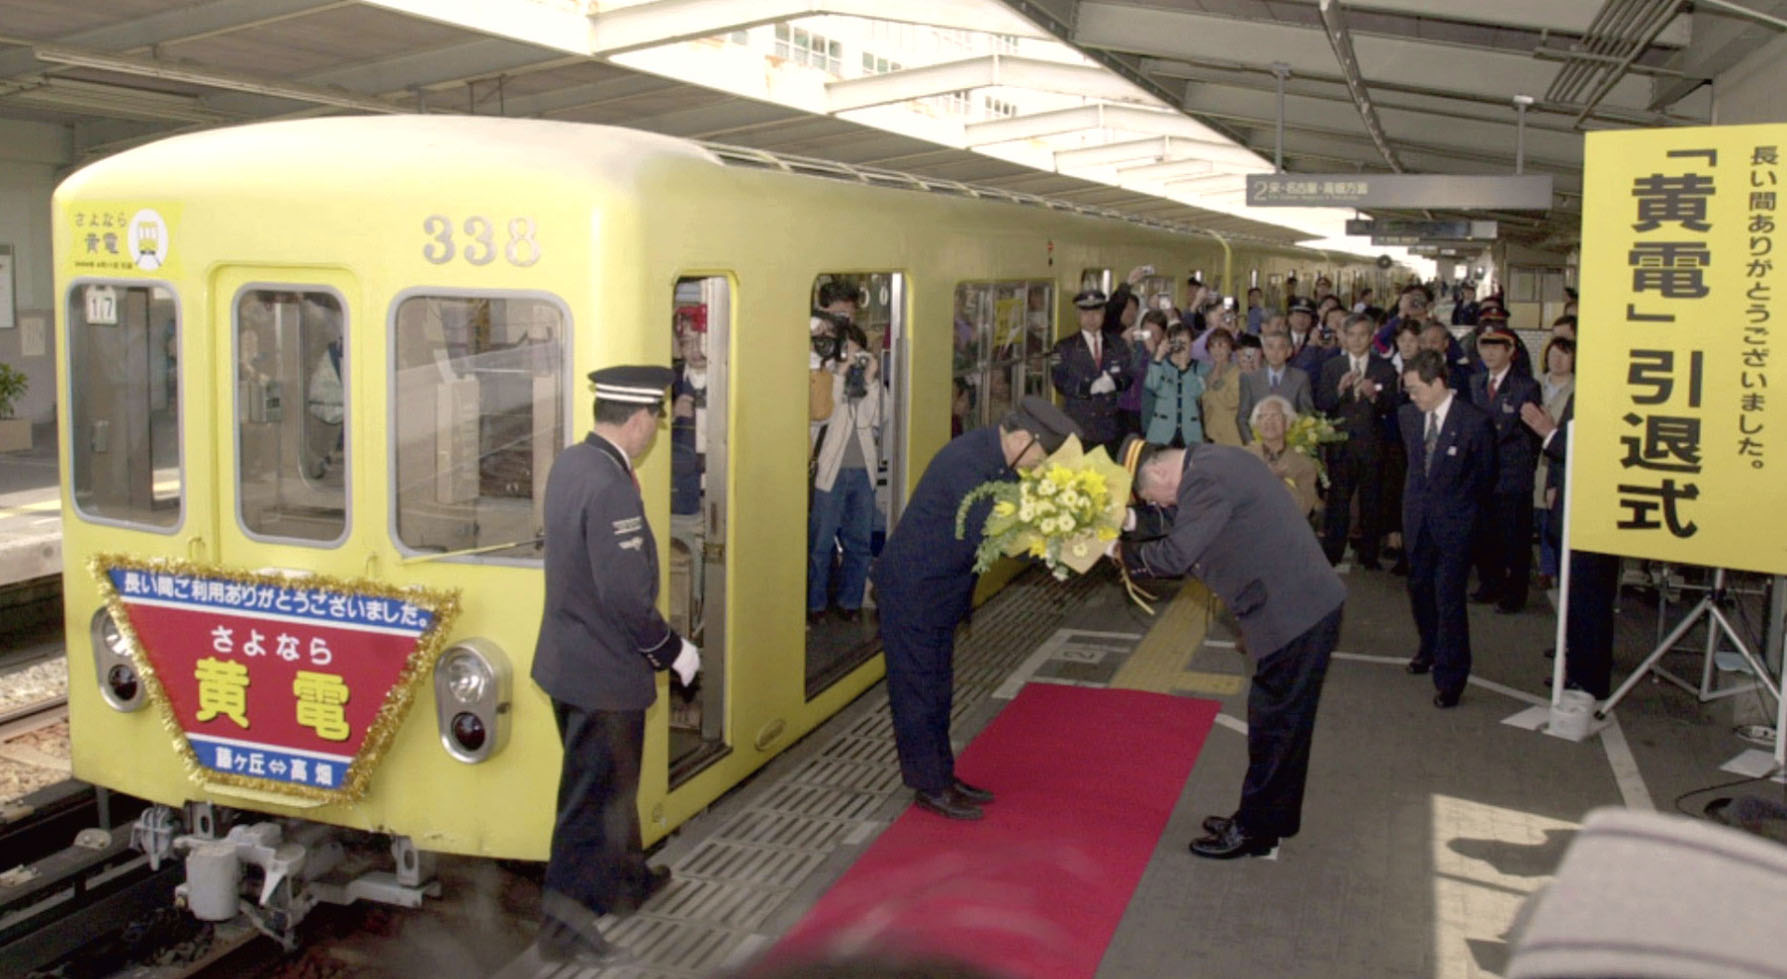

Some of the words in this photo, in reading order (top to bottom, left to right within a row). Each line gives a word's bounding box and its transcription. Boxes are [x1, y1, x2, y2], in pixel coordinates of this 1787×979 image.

[1254, 181, 1267, 201] 2
[75, 211, 127, 228] さよなら
[85, 232, 119, 255] 黄電
[422, 214, 541, 267] 338
[1737, 145, 1779, 471] 長い間ありがとうございました。
[1616, 148, 1718, 540] 「黄電」引退式
[124, 572, 428, 628] 長い間ご利用ありがとうございました。
[210, 625, 334, 666] さよなら
[194, 656, 350, 742] 黄電
